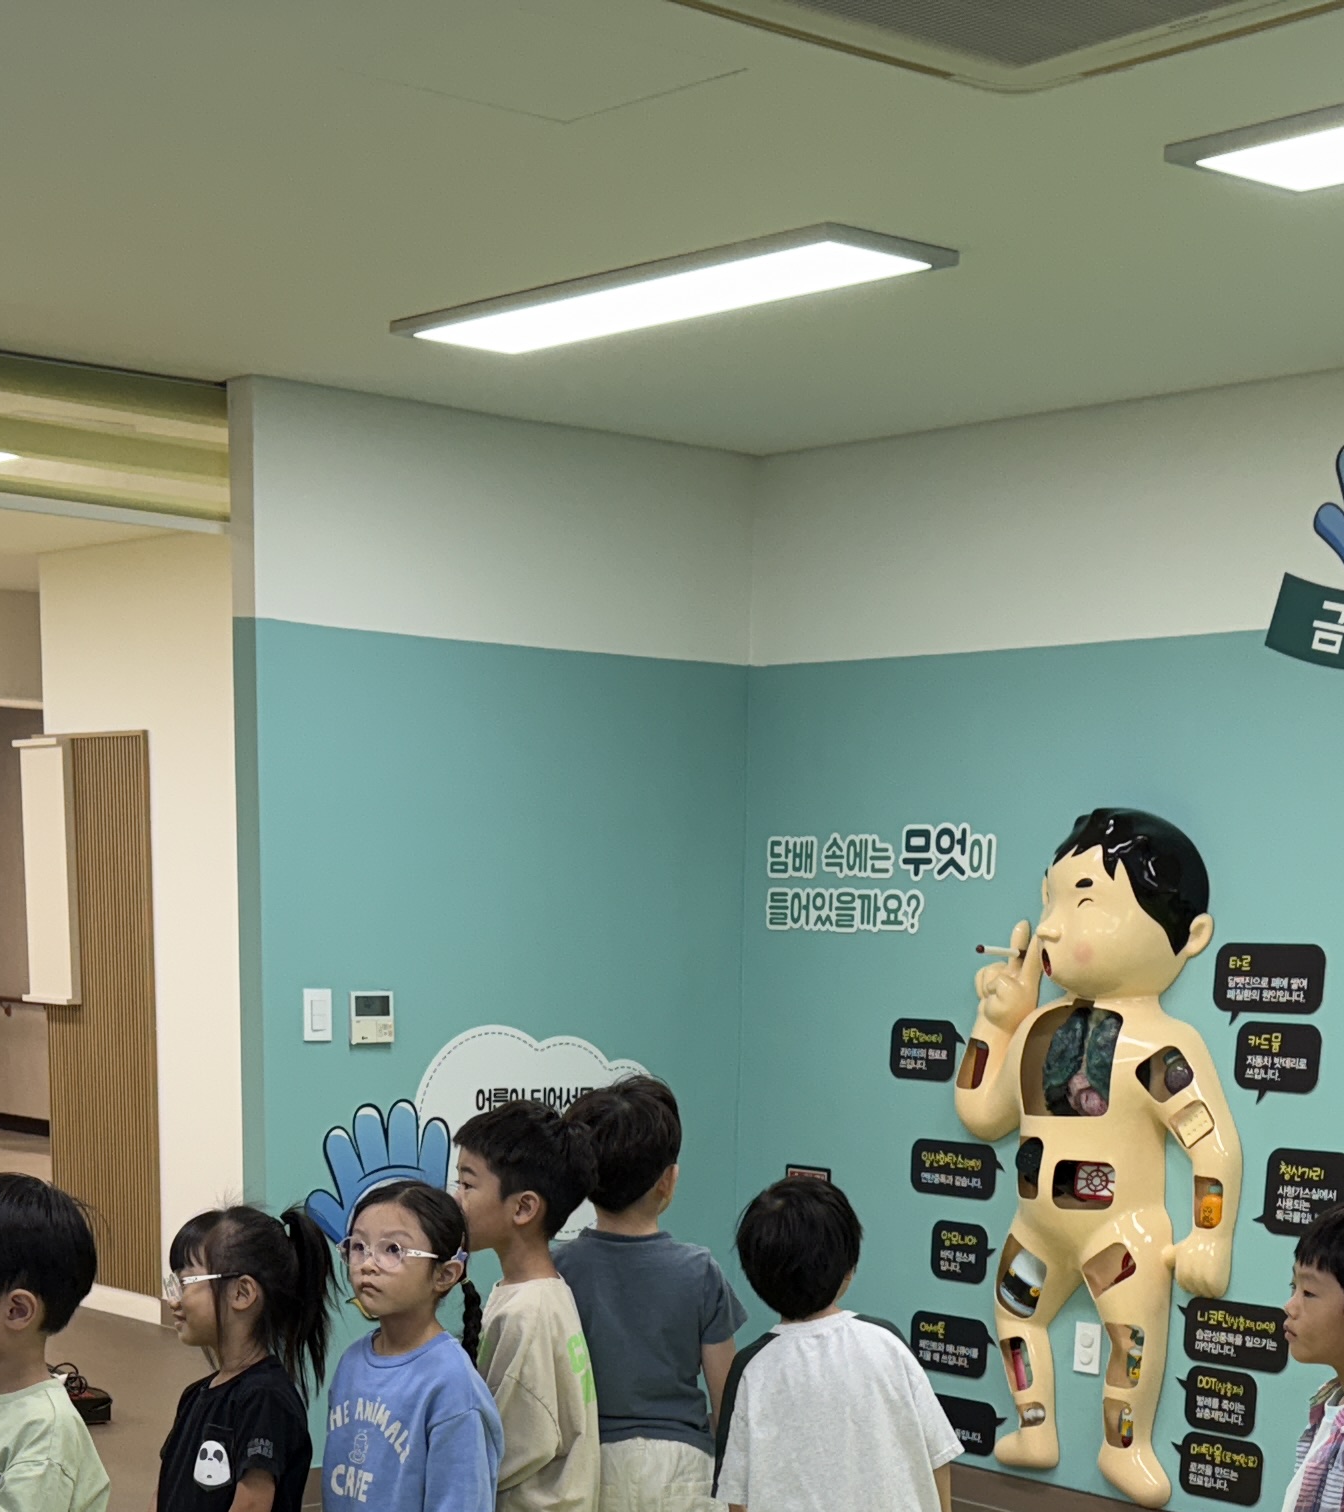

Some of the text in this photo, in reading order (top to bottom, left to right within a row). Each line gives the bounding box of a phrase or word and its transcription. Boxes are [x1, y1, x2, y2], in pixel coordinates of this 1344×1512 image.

[769, 826, 993, 877] 담배 속에는 무엇이
[768, 891, 921, 930] 들어있을까요?
[1228, 955, 1251, 971] 타르
[1247, 1032, 1282, 1053] 카드뮴
[1244, 1068, 1281, 1081] 쓰입니다.
[1279, 1160, 1325, 1182] 청산가리
[940, 1230, 978, 1246] 암모니아
[329, 1399, 350, 1431] HE
[330, 1463, 374, 1503] CAFE
